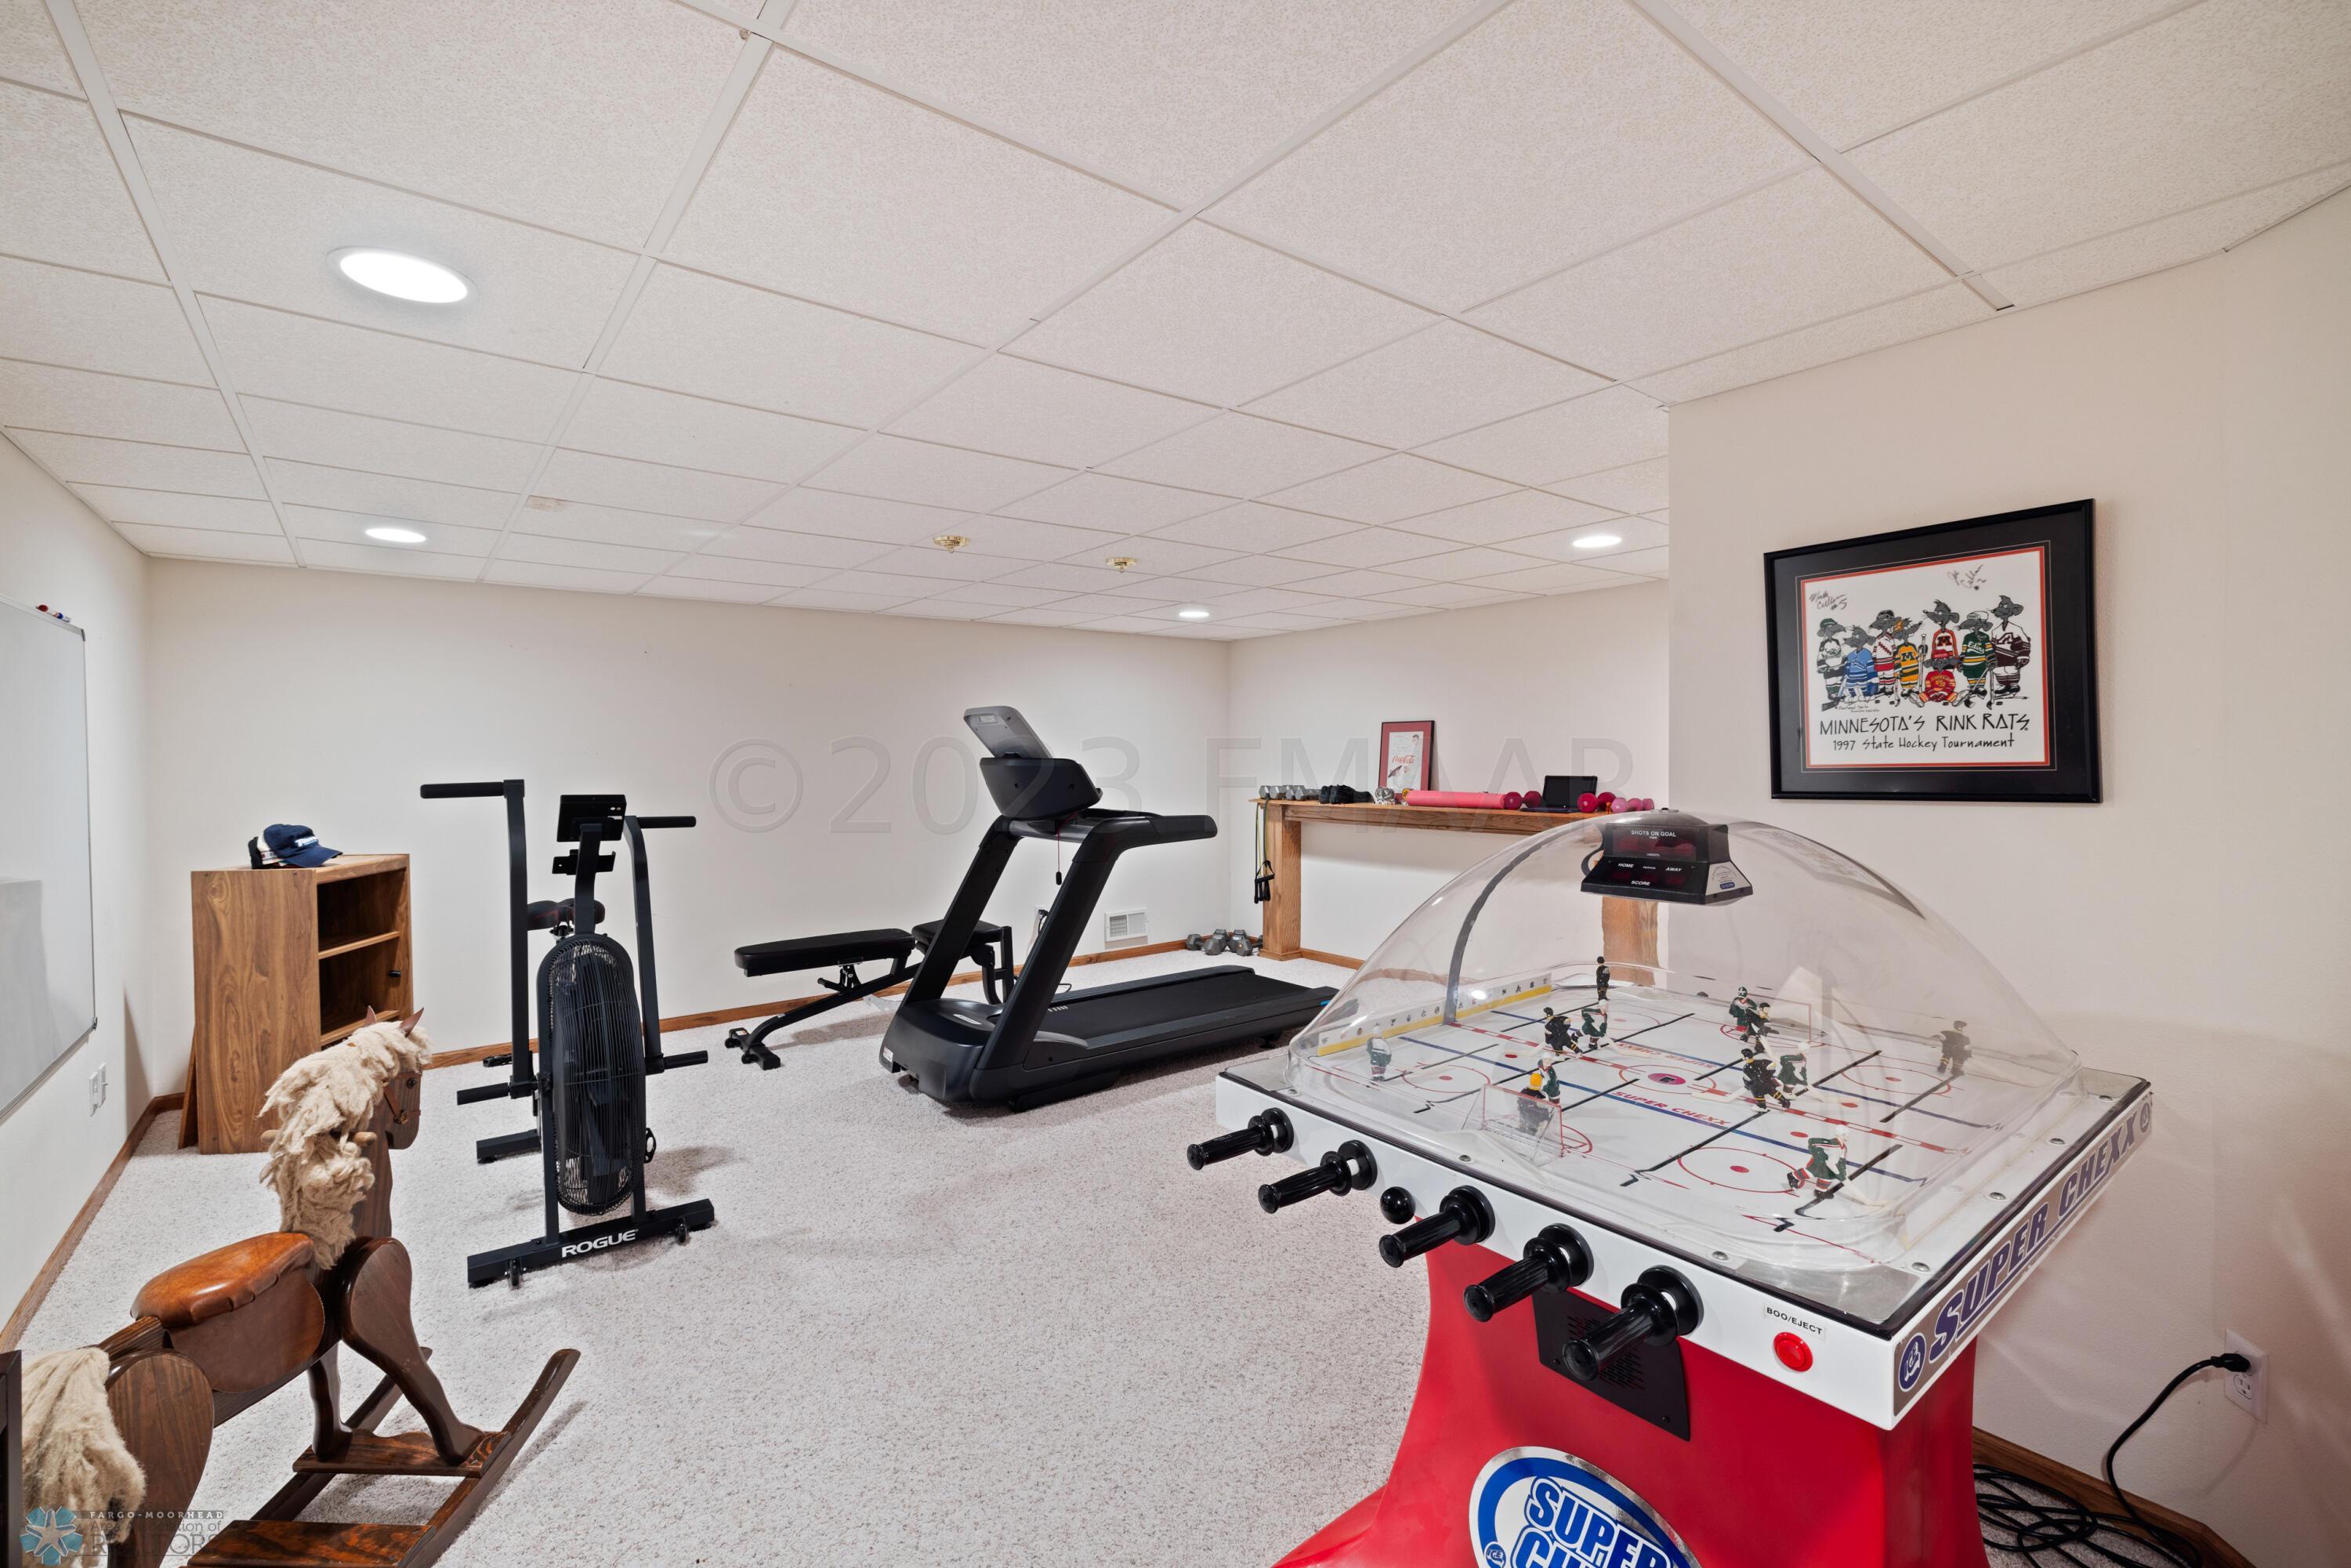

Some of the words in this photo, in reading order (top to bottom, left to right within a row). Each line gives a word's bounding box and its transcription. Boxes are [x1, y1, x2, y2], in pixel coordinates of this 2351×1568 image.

[1820, 715, 1925, 735] MINNESOTA'S
[1936, 714, 1977, 731] RINK
[1982, 713, 2030, 730] RATS
[1833, 740, 1856, 751] 1997
[1863, 735, 1894, 750] State
[1899, 734, 1937, 752] Hockey
[1942, 732, 2015, 748] Tournament
[1612, 1092, 1668, 1108] SUPER
[1672, 1107, 1731, 1126] CHEXX
[561, 1229, 637, 1258] ROGUE
[1929, 1201, 2049, 1364] SUPER
[2058, 1110, 2139, 1217] CHEXX
[1766, 1307, 1823, 1334] BOO/EJECT
